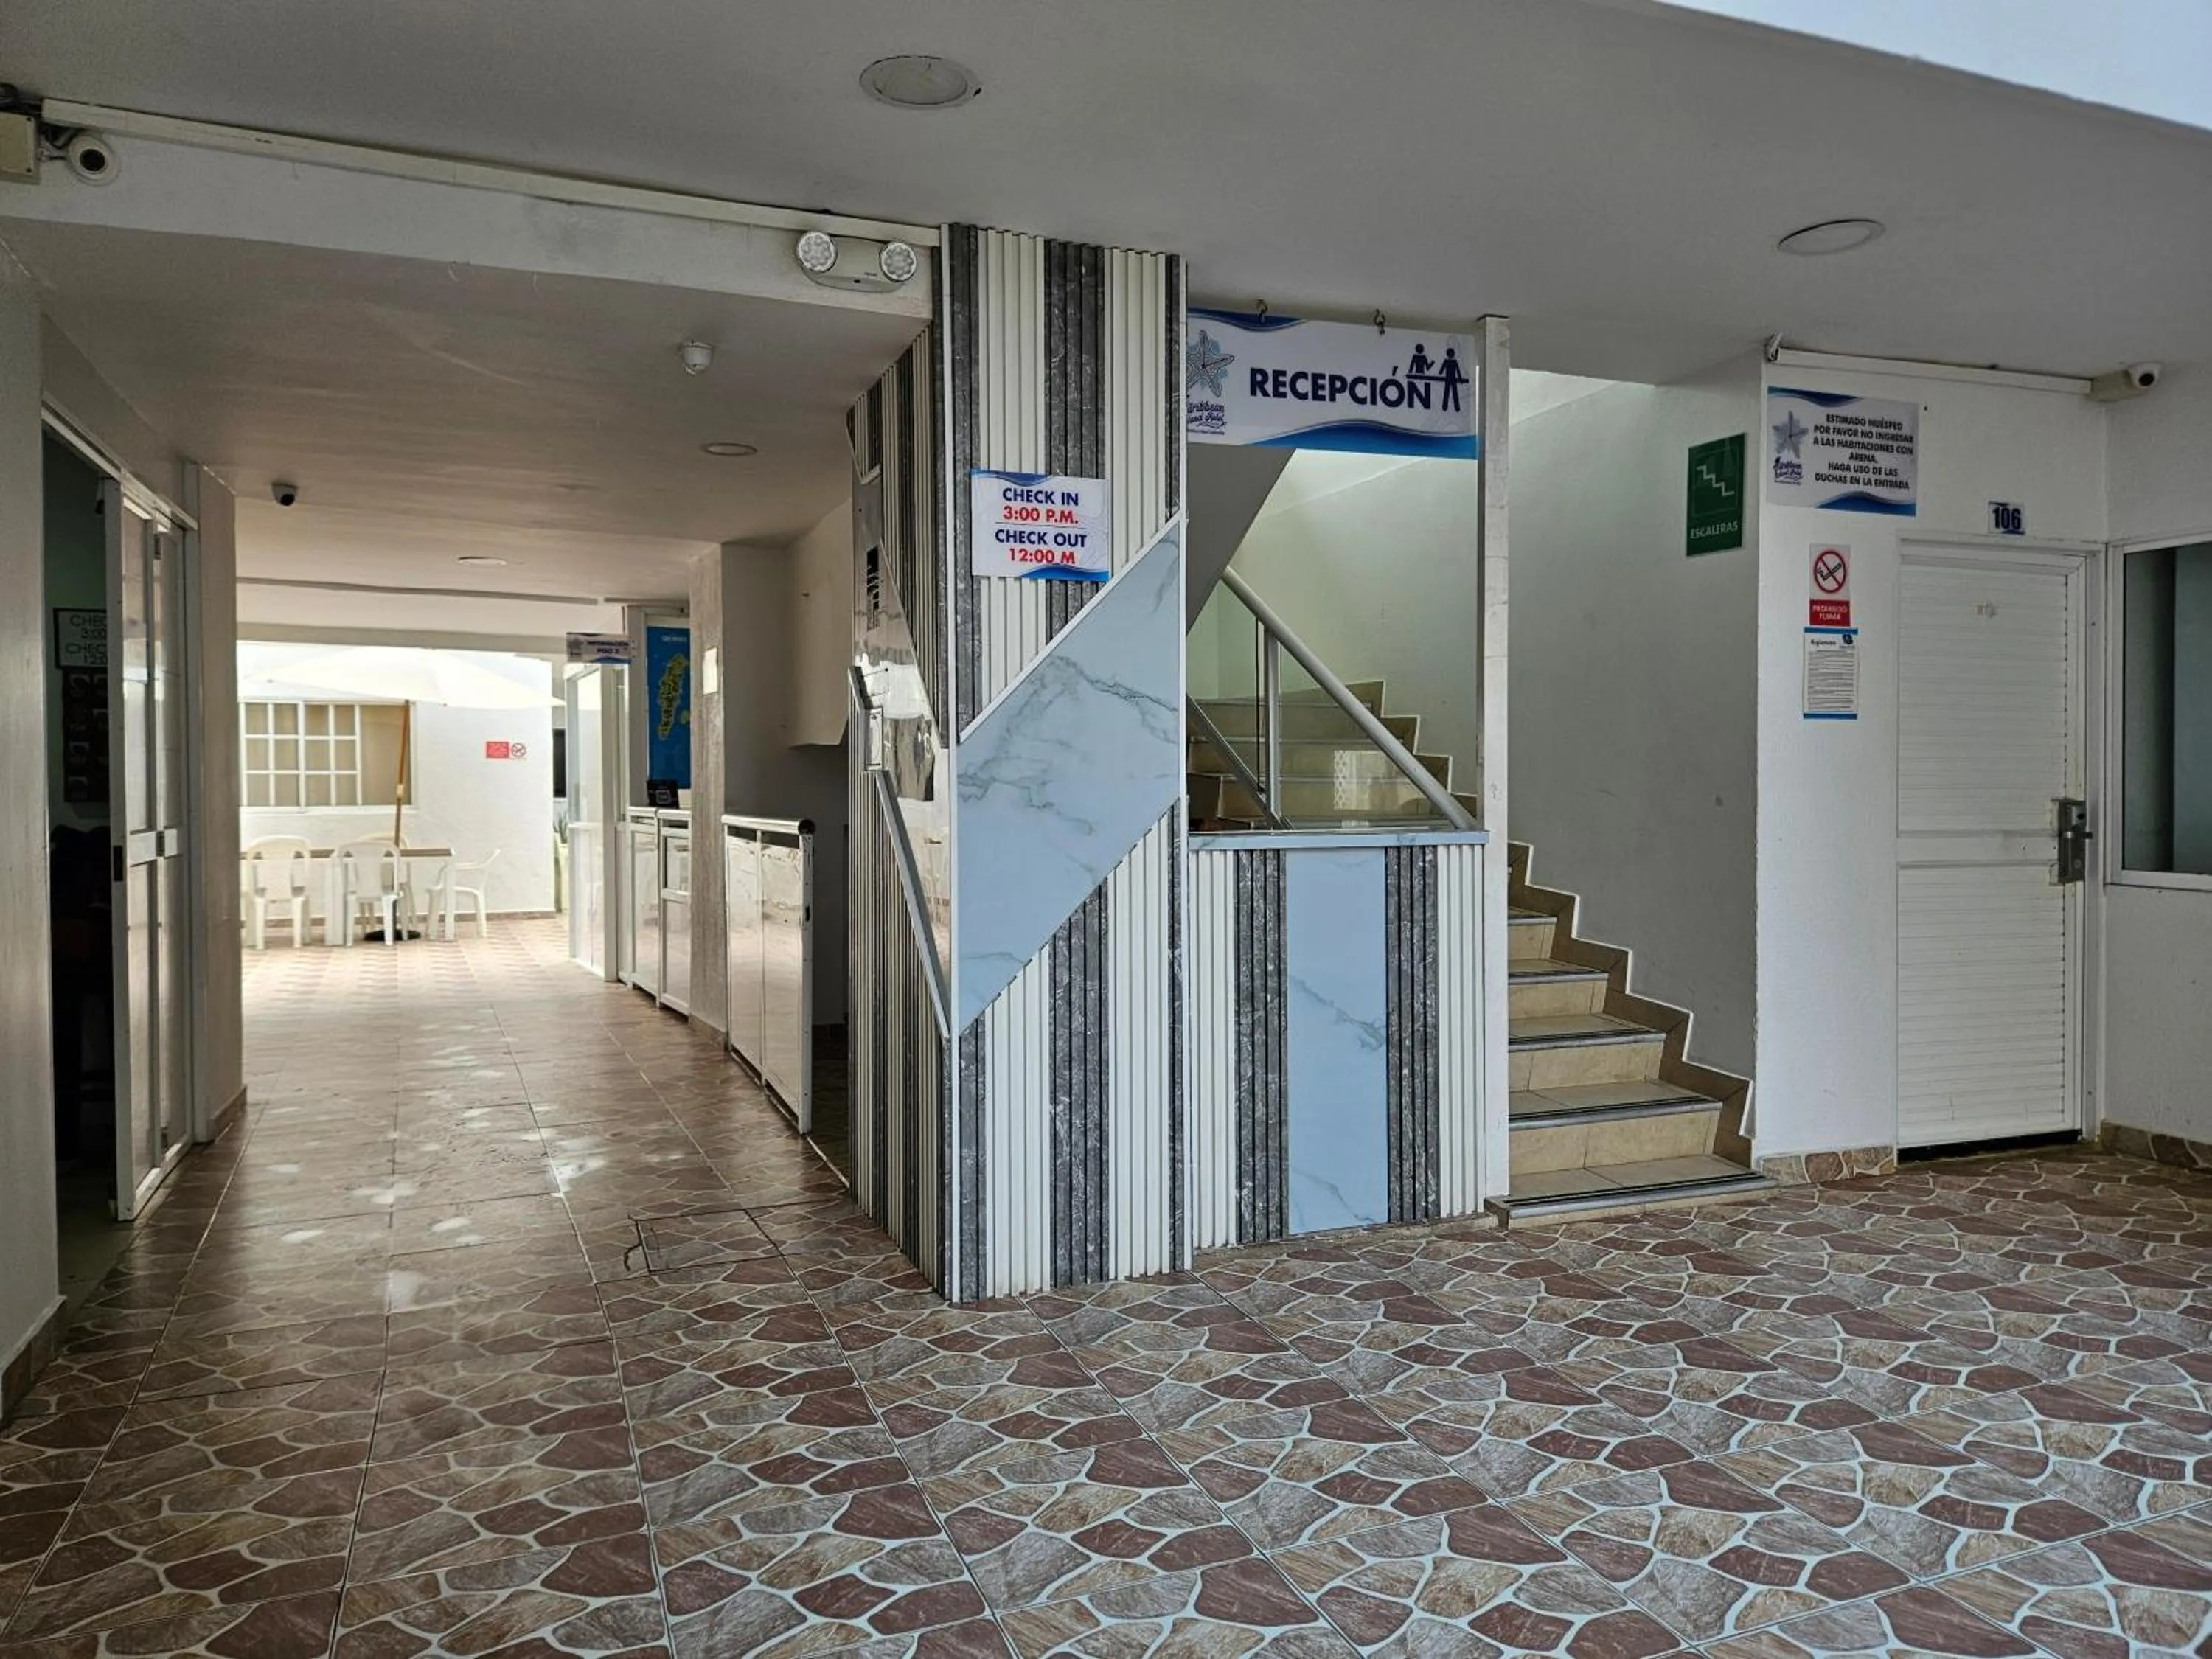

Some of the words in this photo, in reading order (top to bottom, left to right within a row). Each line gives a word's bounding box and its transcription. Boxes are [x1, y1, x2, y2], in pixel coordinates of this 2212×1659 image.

[1250, 365, 1431, 410] RECEPCIÓN
[1826, 414, 1866, 427] ESTIMADO
[1814, 425, 1831, 435] POR
[1832, 427, 1859, 438] FAVOR
[1860, 429, 1874, 439] NO
[1875, 431, 1913, 443] INGRESAR
[1813, 437, 1819, 445] A
[1820, 437, 1835, 448] LAS
[1837, 439, 1894, 453] HABITACIONES
[1896, 445, 1913, 456] CON
[1828, 462, 1851, 473] HAGA
[1853, 465, 1871, 475] USO
[1872, 466, 1882, 476] DE
[1884, 467, 1899, 477] LAS
[1815, 473, 1847, 485] DUCHAS
[1849, 476, 1861, 485] EN
[1863, 476, 1873, 487] LA
[1874, 478, 1910, 490] ENTRADA
[1002, 487, 1055, 505] CHECK
[1061, 492, 1079, 507] IN
[1003, 505, 1040, 521] 3:00
[1046, 508, 1079, 524] P.M.
[1992, 507, 2022, 529] 106
[995, 529, 1048, 546] CHECK
[1054, 532, 1087, 548] OUT
[1690, 521, 1738, 539] ESCALERAS
[1009, 548, 1055, 563] 12:00
[1060, 552, 1075, 564] M
[65, 642, 107, 654] CHEC
